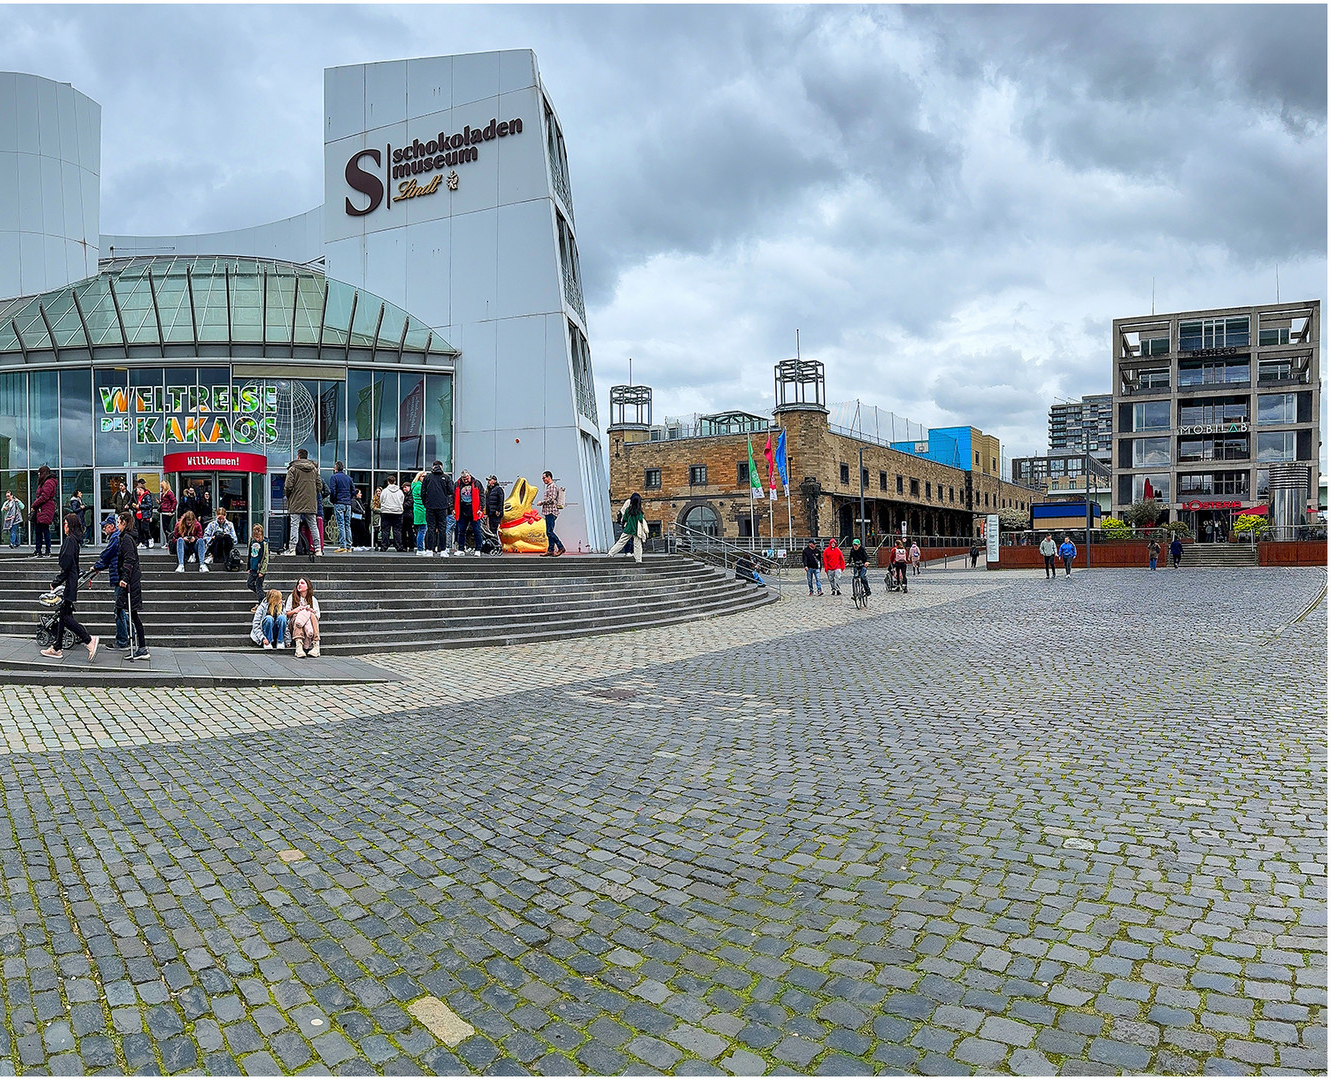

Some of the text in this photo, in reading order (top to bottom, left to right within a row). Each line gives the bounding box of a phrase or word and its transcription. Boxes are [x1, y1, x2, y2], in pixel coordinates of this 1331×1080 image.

[392, 117, 523, 164] schokoladen
[392, 146, 478, 179] museum
[345, 149, 384, 216] S
[392, 174, 442, 203] Lindt
[99, 385, 277, 413] WELTREISE
[100, 416, 278, 444] DES KAKAOS
[1180, 419, 1248, 435] MOBILAB
[187, 456, 239, 466] Willkommen!
[1182, 500, 1241, 511] L'OSTERIA
